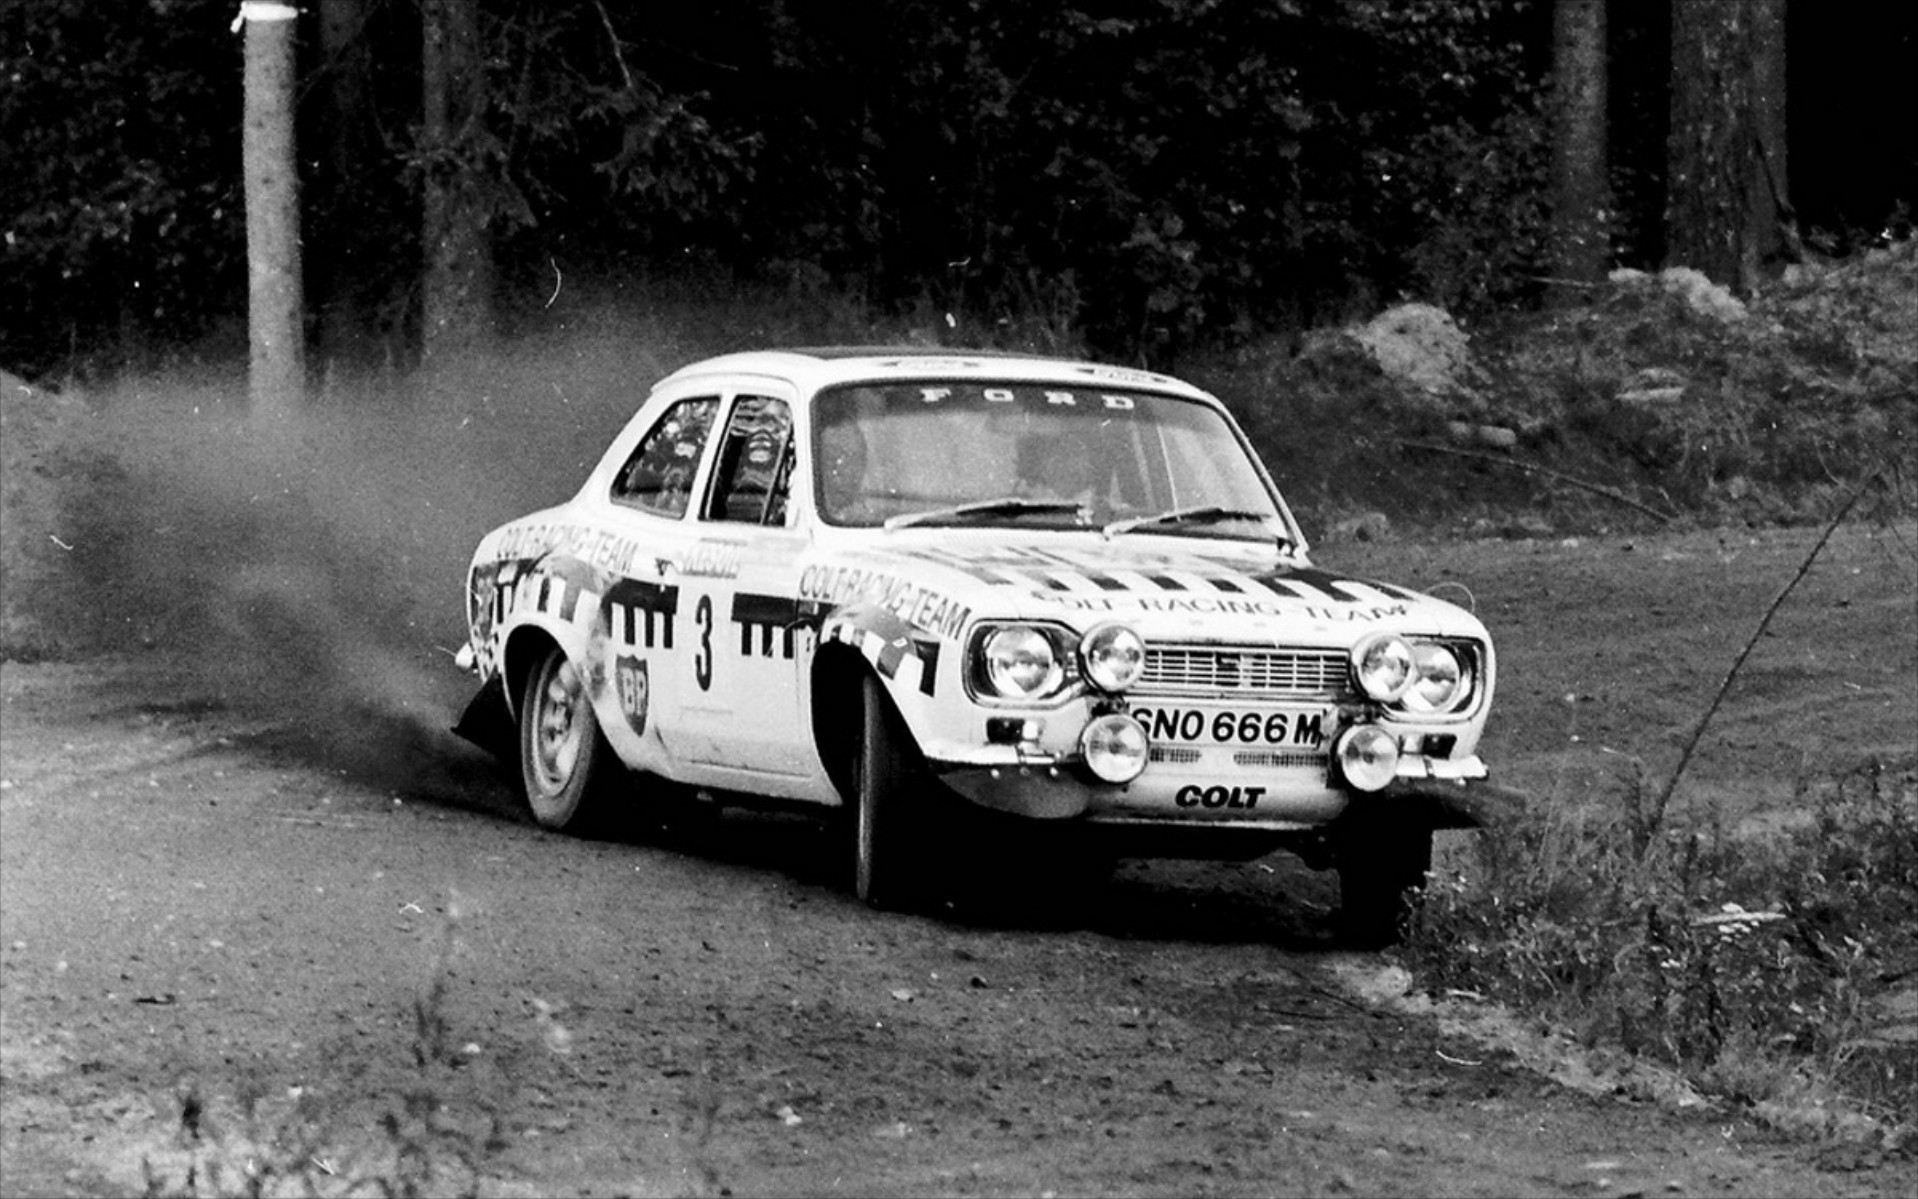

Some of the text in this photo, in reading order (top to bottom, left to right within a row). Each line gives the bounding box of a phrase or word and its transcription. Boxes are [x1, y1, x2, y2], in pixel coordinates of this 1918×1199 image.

[919, 387, 1136, 410] FORD
[589, 530, 639, 573] TEAM
[799, 564, 848, 602] COLT
[909, 587, 972, 640] TEAM
[1138, 598, 1281, 616] RACING
[1301, 603, 1408, 622] TEAM
[695, 594, 713, 692] 3
[1131, 708, 1323, 748] SNO 666 M
[1175, 785, 1267, 809] COLT
